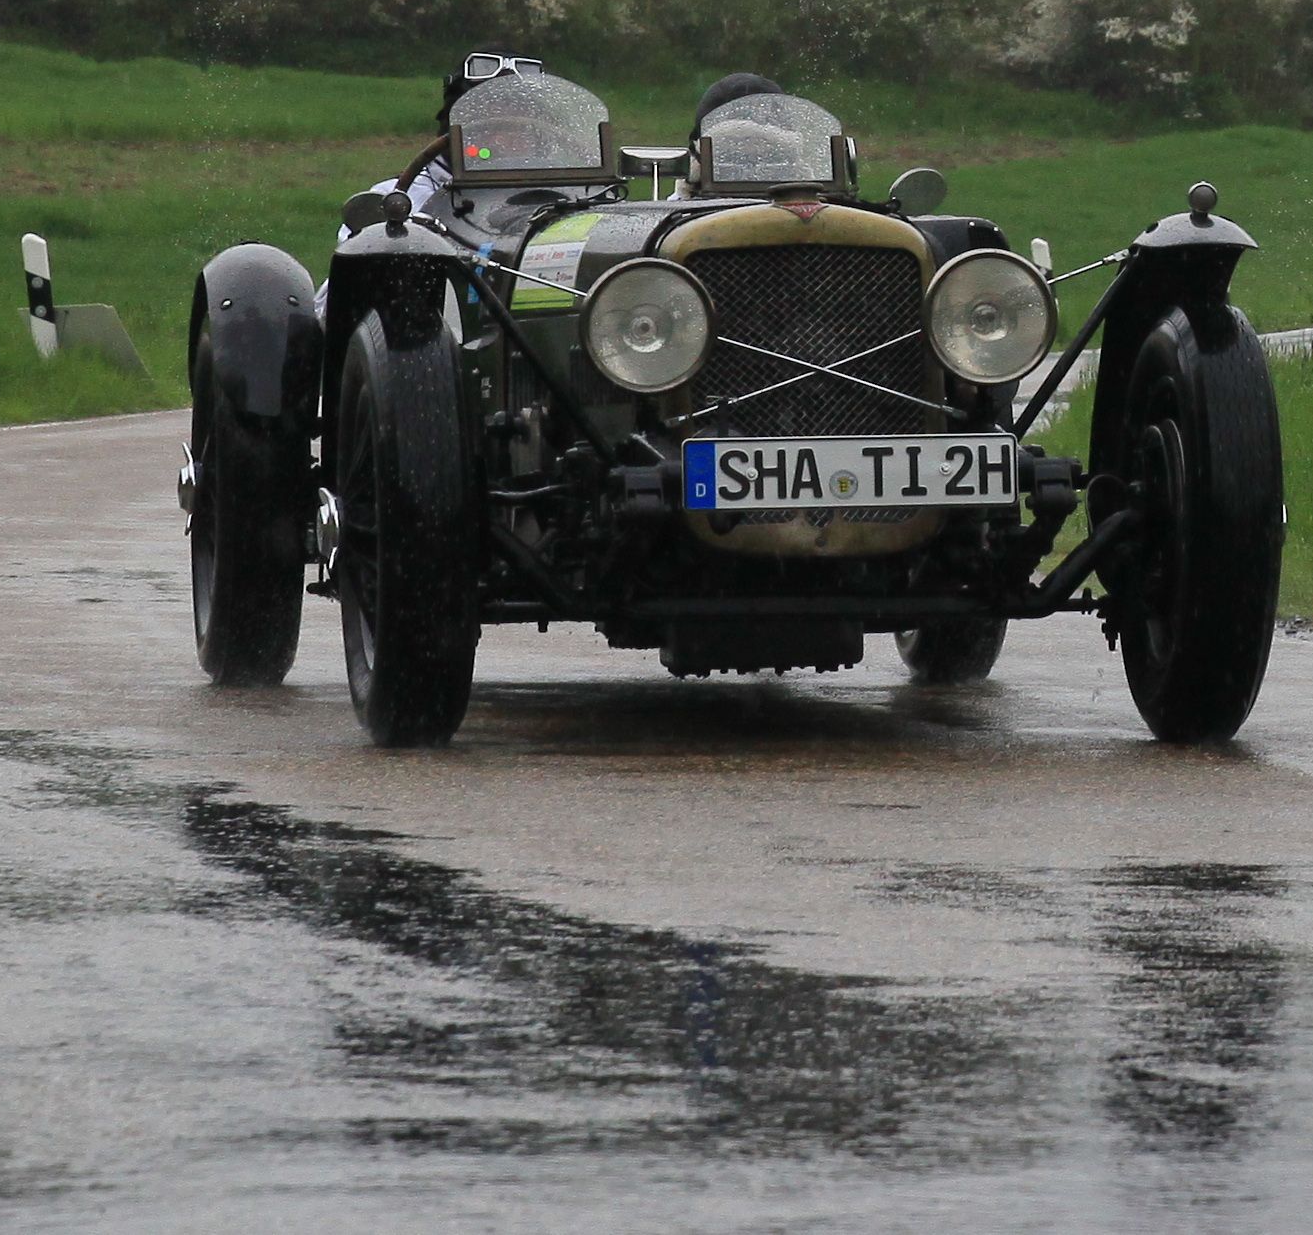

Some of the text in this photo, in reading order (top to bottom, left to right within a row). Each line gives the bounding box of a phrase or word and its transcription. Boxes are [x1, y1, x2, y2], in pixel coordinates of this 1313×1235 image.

[696, 483, 706, 497] D
[718, 444, 1012, 501] SHA TI 2H
